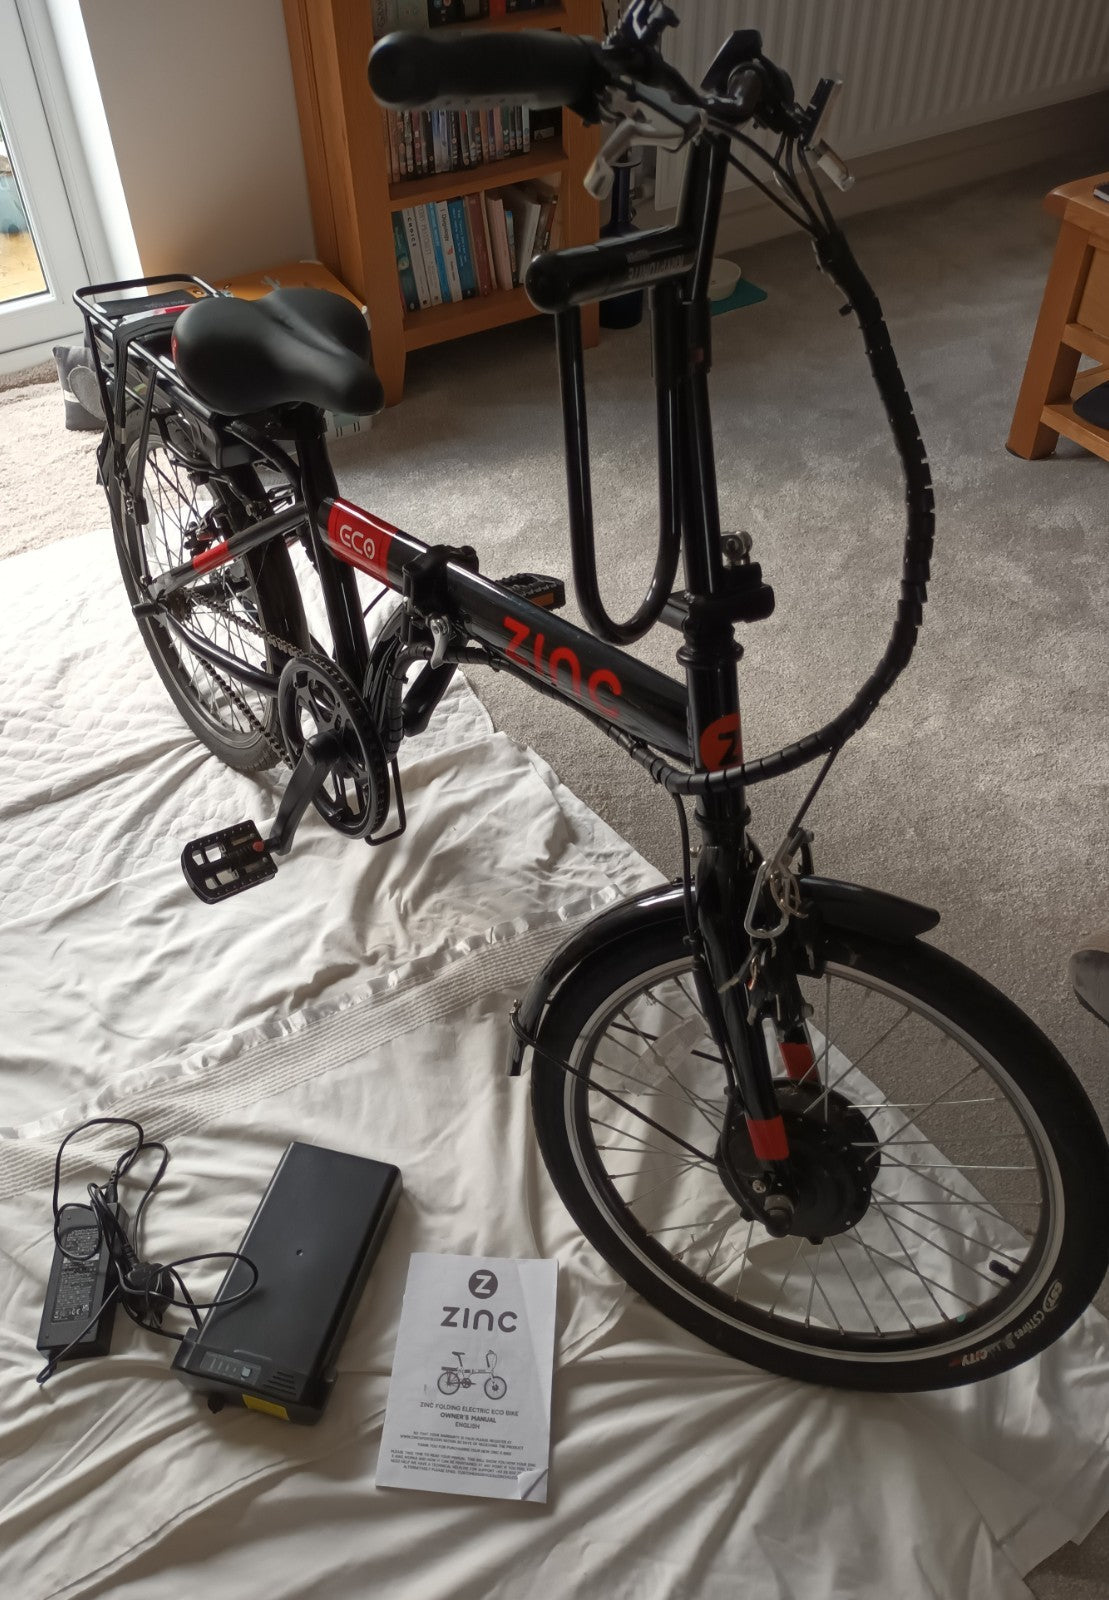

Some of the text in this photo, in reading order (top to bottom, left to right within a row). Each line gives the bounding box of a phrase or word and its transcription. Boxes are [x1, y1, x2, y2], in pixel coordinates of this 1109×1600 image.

[340, 524, 375, 560] ECO
[475, 1274, 492, 1294] Z
[440, 1306, 518, 1333] ZINC
[435, 1403, 460, 1411] FOLDING
[462, 1406, 490, 1414] ELECTRIC
[440, 1412, 496, 1424] OWNER'S MANUAL
[455, 1422, 480, 1430] ENGLISH
